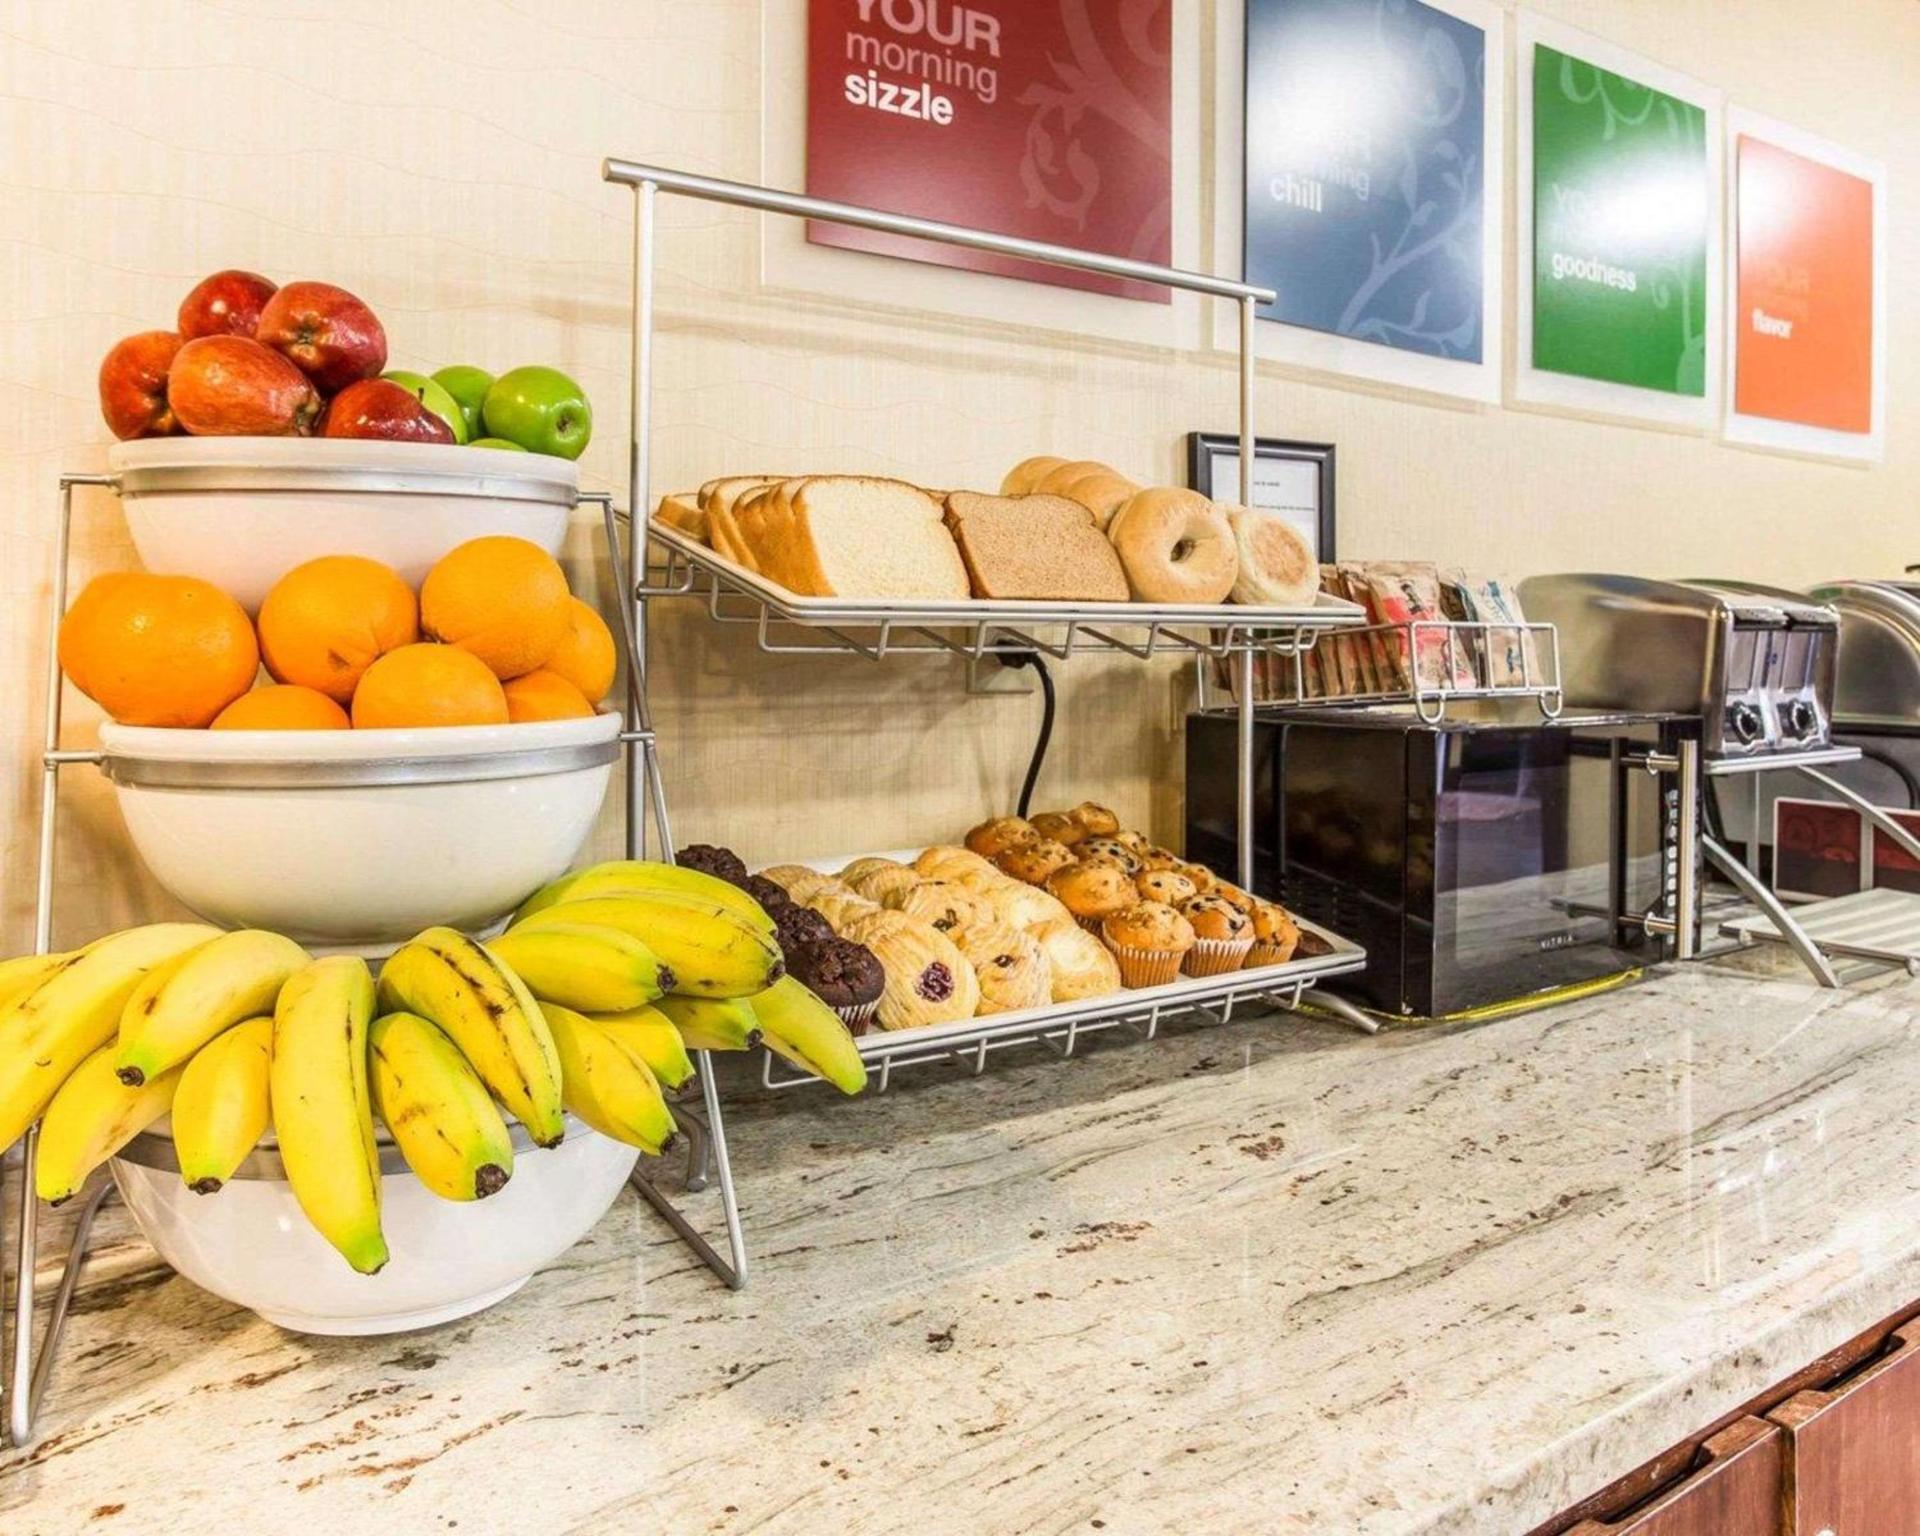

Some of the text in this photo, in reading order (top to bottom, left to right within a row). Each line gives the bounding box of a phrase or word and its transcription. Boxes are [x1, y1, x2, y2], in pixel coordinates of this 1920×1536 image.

[856, 0, 1001, 58] YOUR
[846, 32, 998, 104] morning
[844, 69, 954, 126] sizzle
[1269, 172, 1323, 213] chill
[1551, 253, 1637, 292] goodness
